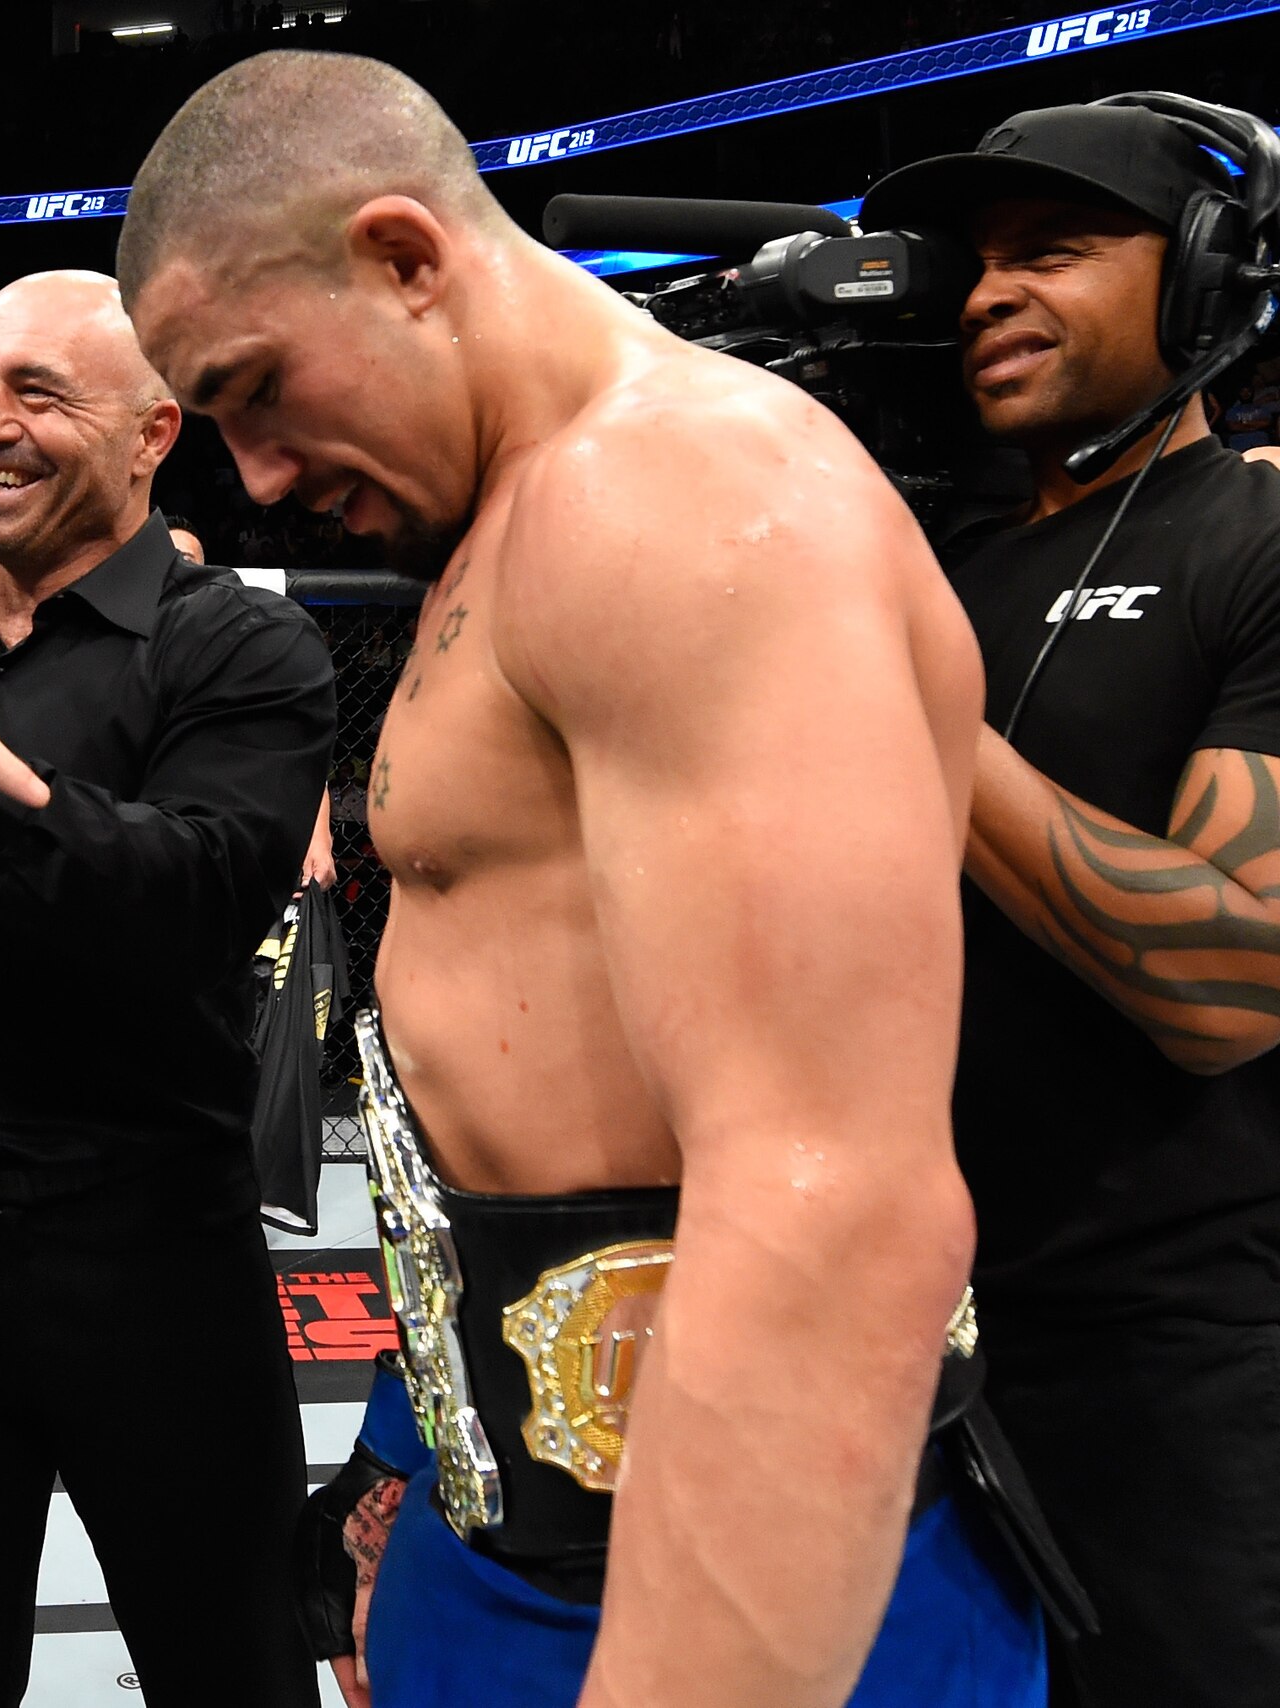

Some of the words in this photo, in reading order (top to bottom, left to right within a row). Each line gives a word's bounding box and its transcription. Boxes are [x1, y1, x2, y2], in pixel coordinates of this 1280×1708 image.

[1026, 11, 1114, 57] UFC
[1113, 9, 1151, 34] 213
[507, 130, 570, 164] UFC
[569, 129, 595, 149] 213
[26, 194, 83, 219] UFC
[81, 196, 105, 211] 213
[1045, 585, 1162, 623] UFC
[288, 1272, 372, 1284] THE
